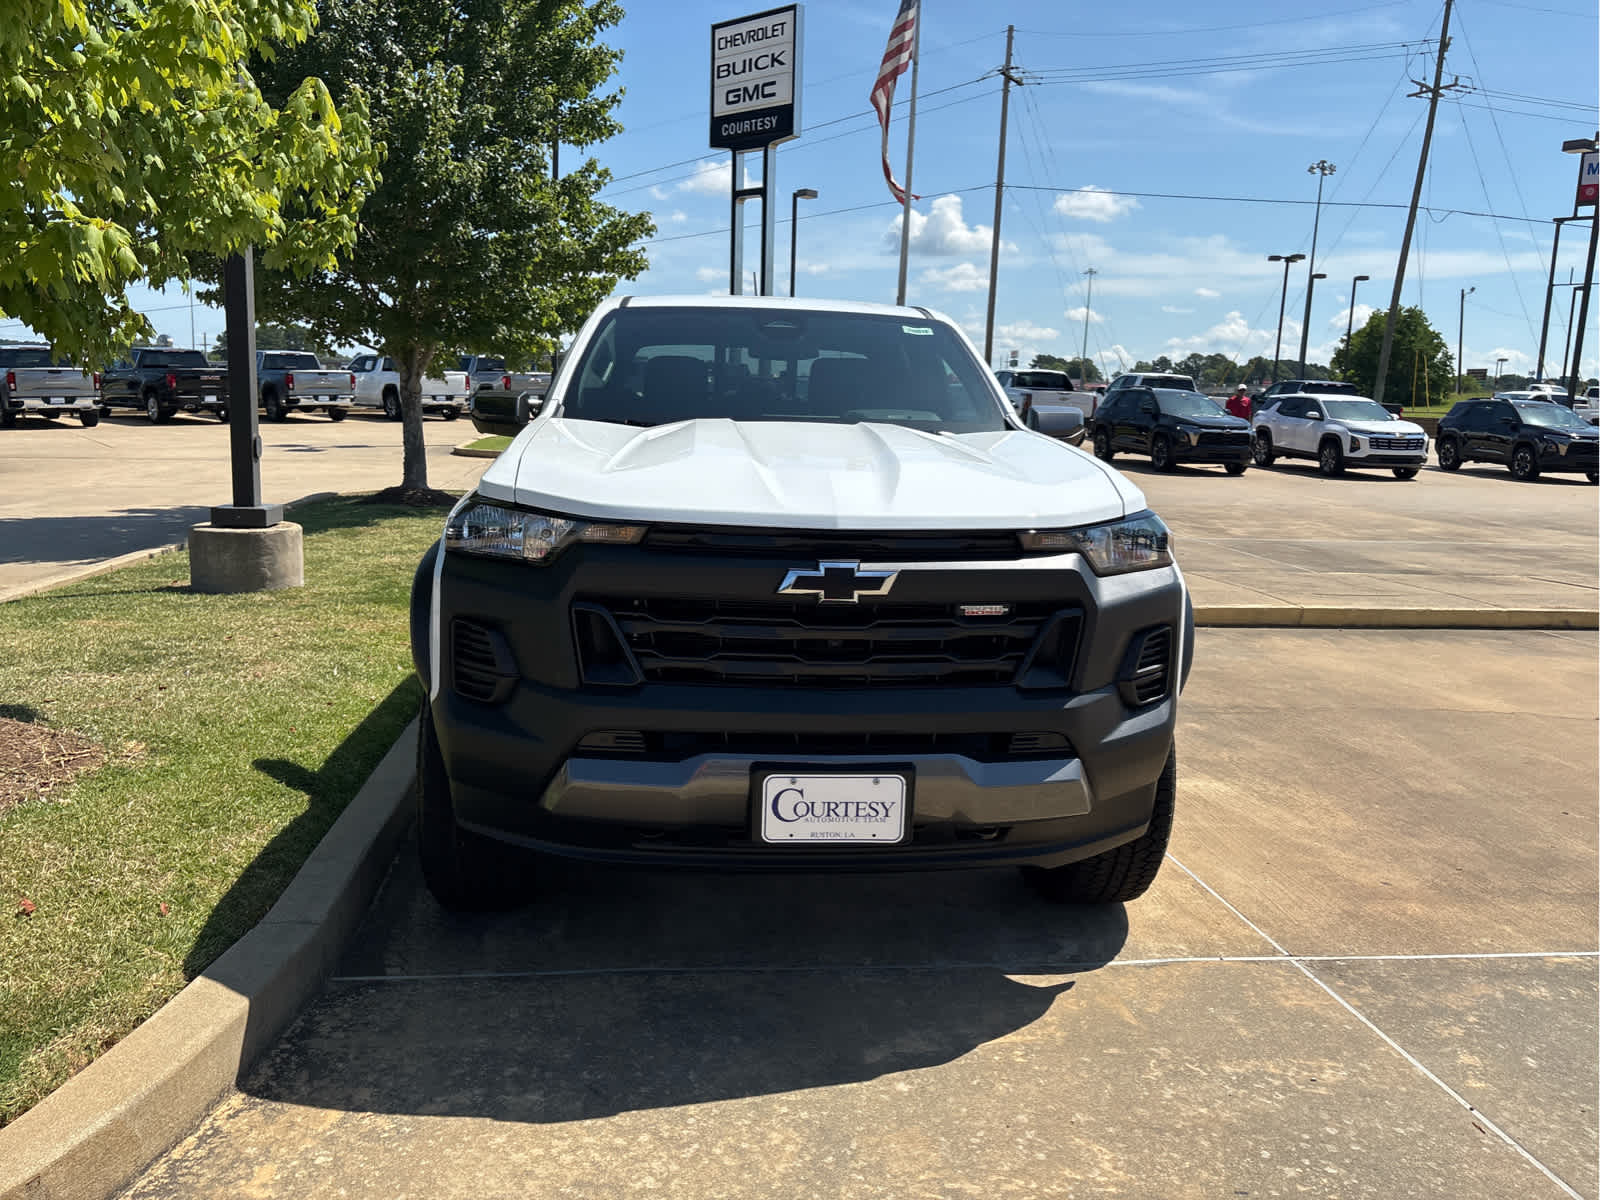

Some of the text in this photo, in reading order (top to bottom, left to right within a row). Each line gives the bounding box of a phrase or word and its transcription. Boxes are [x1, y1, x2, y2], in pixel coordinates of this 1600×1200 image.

[718, 22, 787, 50] CHEVROLET
[717, 50, 786, 79] BUICK
[726, 81, 777, 105] GMC
[721, 116, 778, 136] COURTESY
[771, 788, 896, 822] COURTESY
